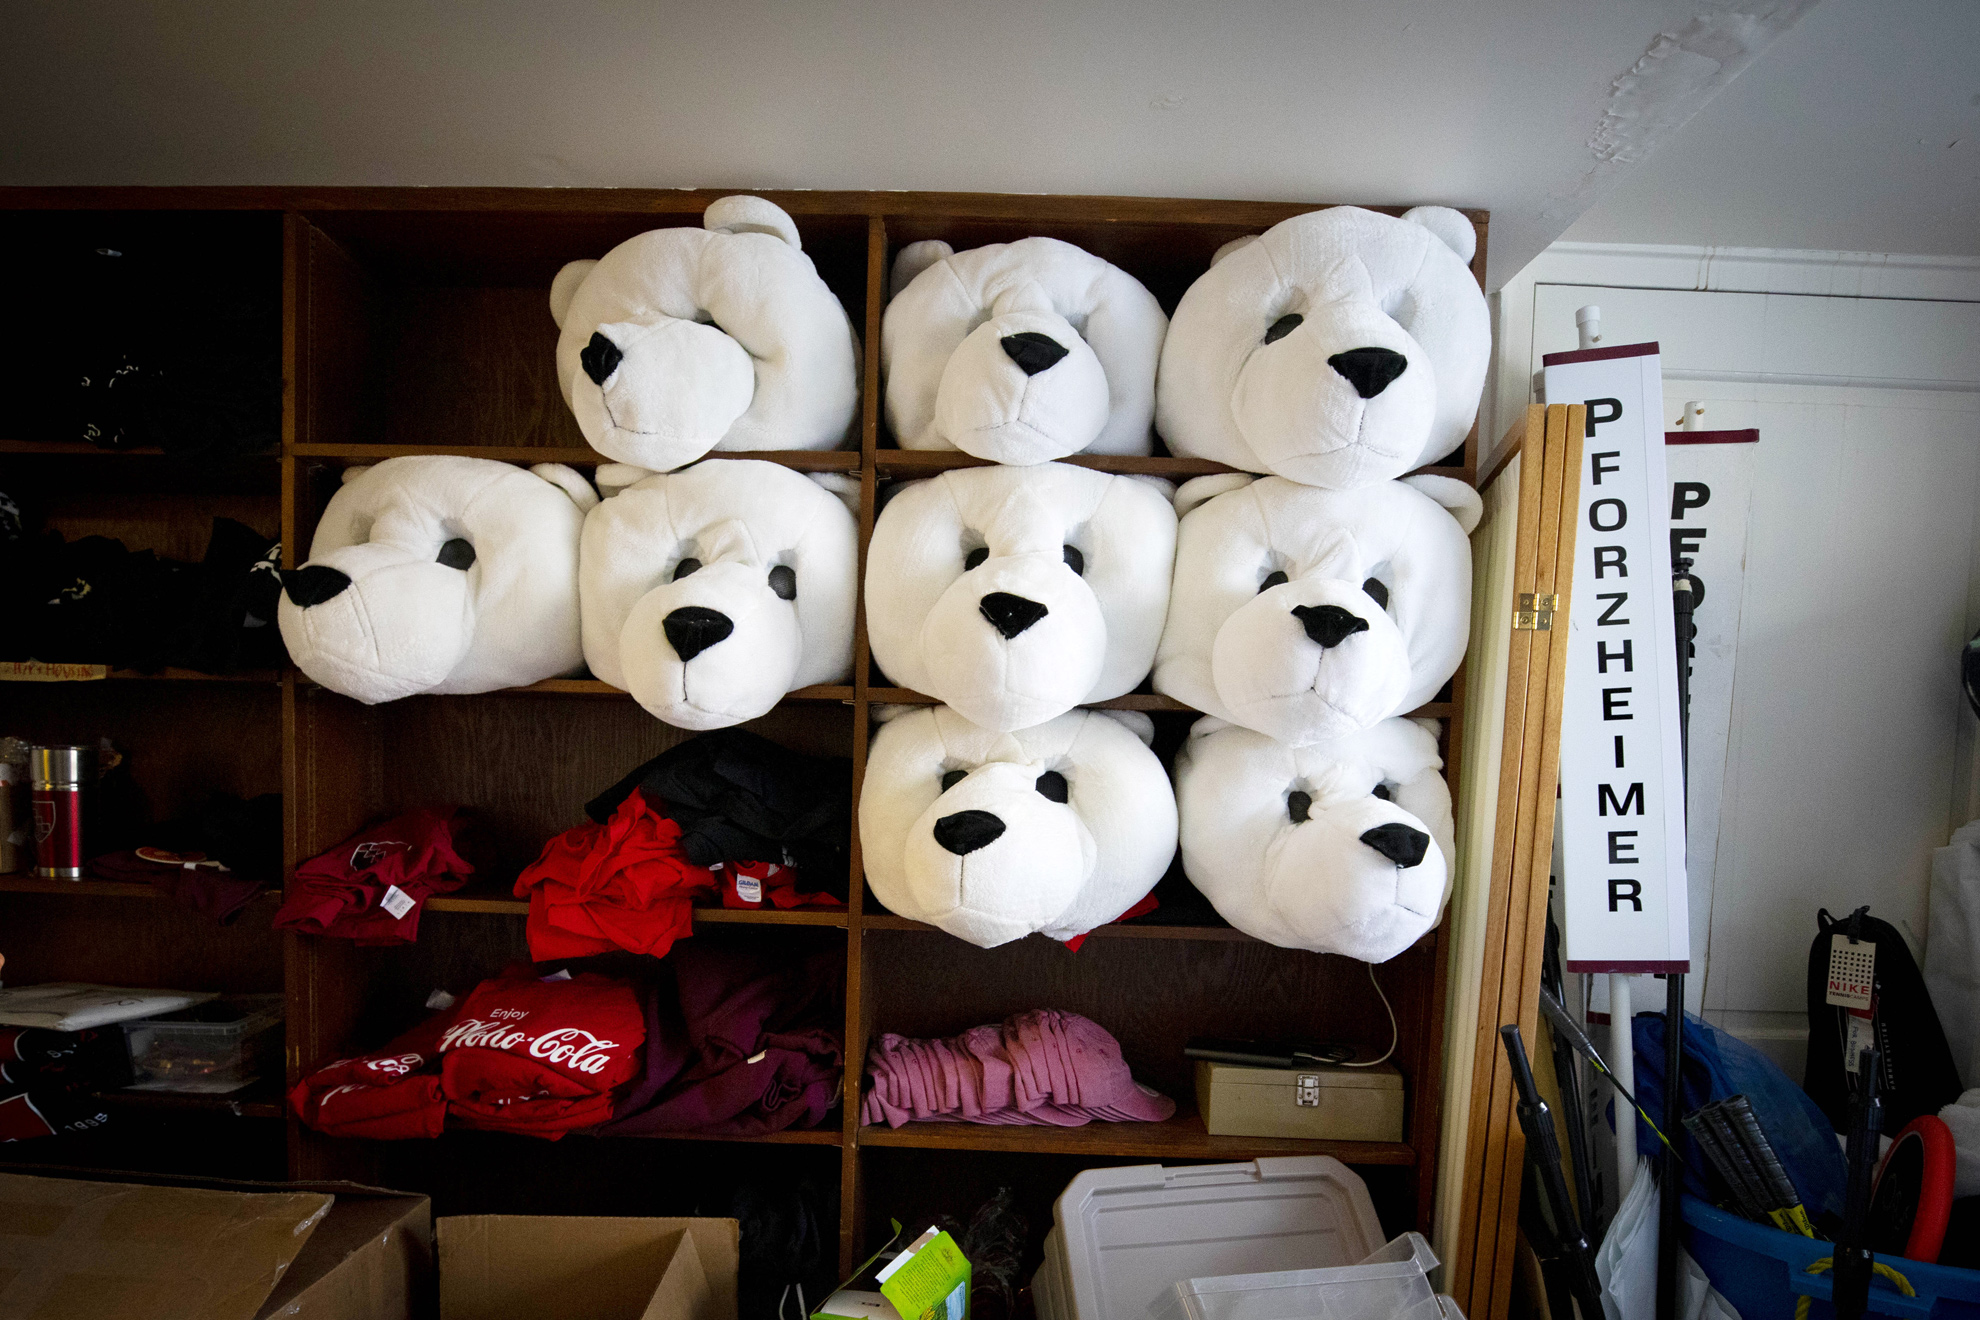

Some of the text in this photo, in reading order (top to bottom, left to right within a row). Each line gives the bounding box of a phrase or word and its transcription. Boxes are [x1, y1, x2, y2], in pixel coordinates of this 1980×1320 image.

[1584, 397, 1645, 912] PFORZHEIMER
[1829, 980, 1869, 995] NIKE
[489, 1008, 530, 1020] Enjoy
